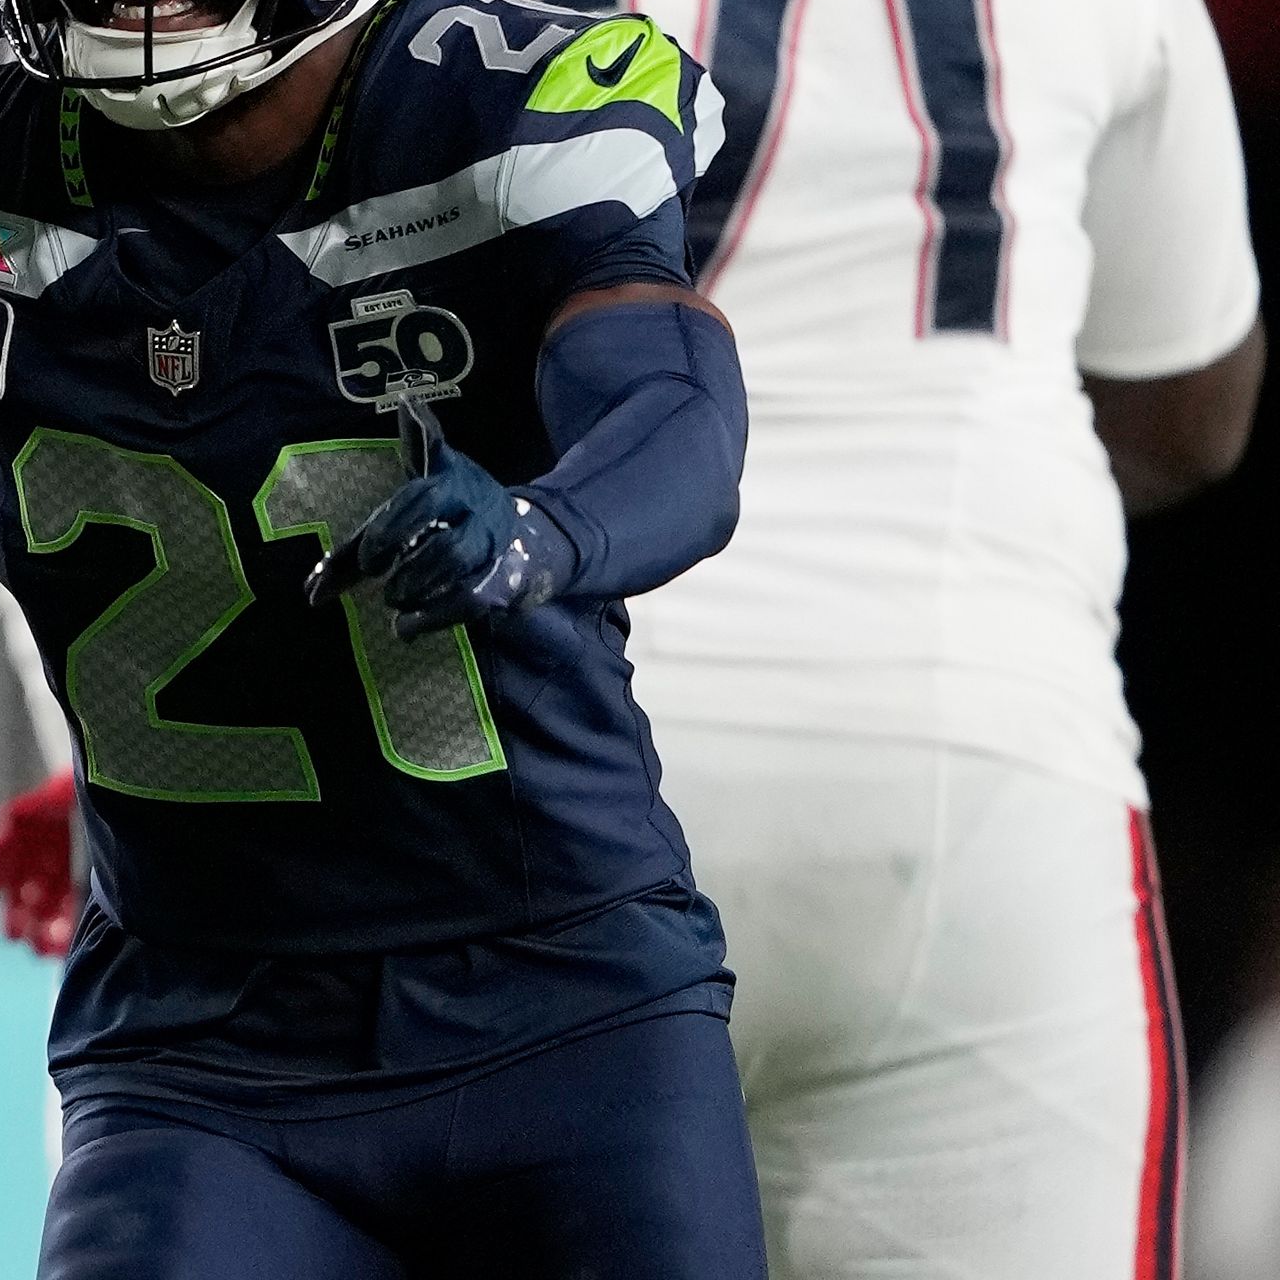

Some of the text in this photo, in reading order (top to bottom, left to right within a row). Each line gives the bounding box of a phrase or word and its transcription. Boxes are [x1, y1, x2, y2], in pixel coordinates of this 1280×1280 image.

[343, 206, 461, 252] SEAHAWKS
[156, 354, 191, 381] NFL
[332, 310, 471, 400] 50
[11, 425, 508, 802] 21
